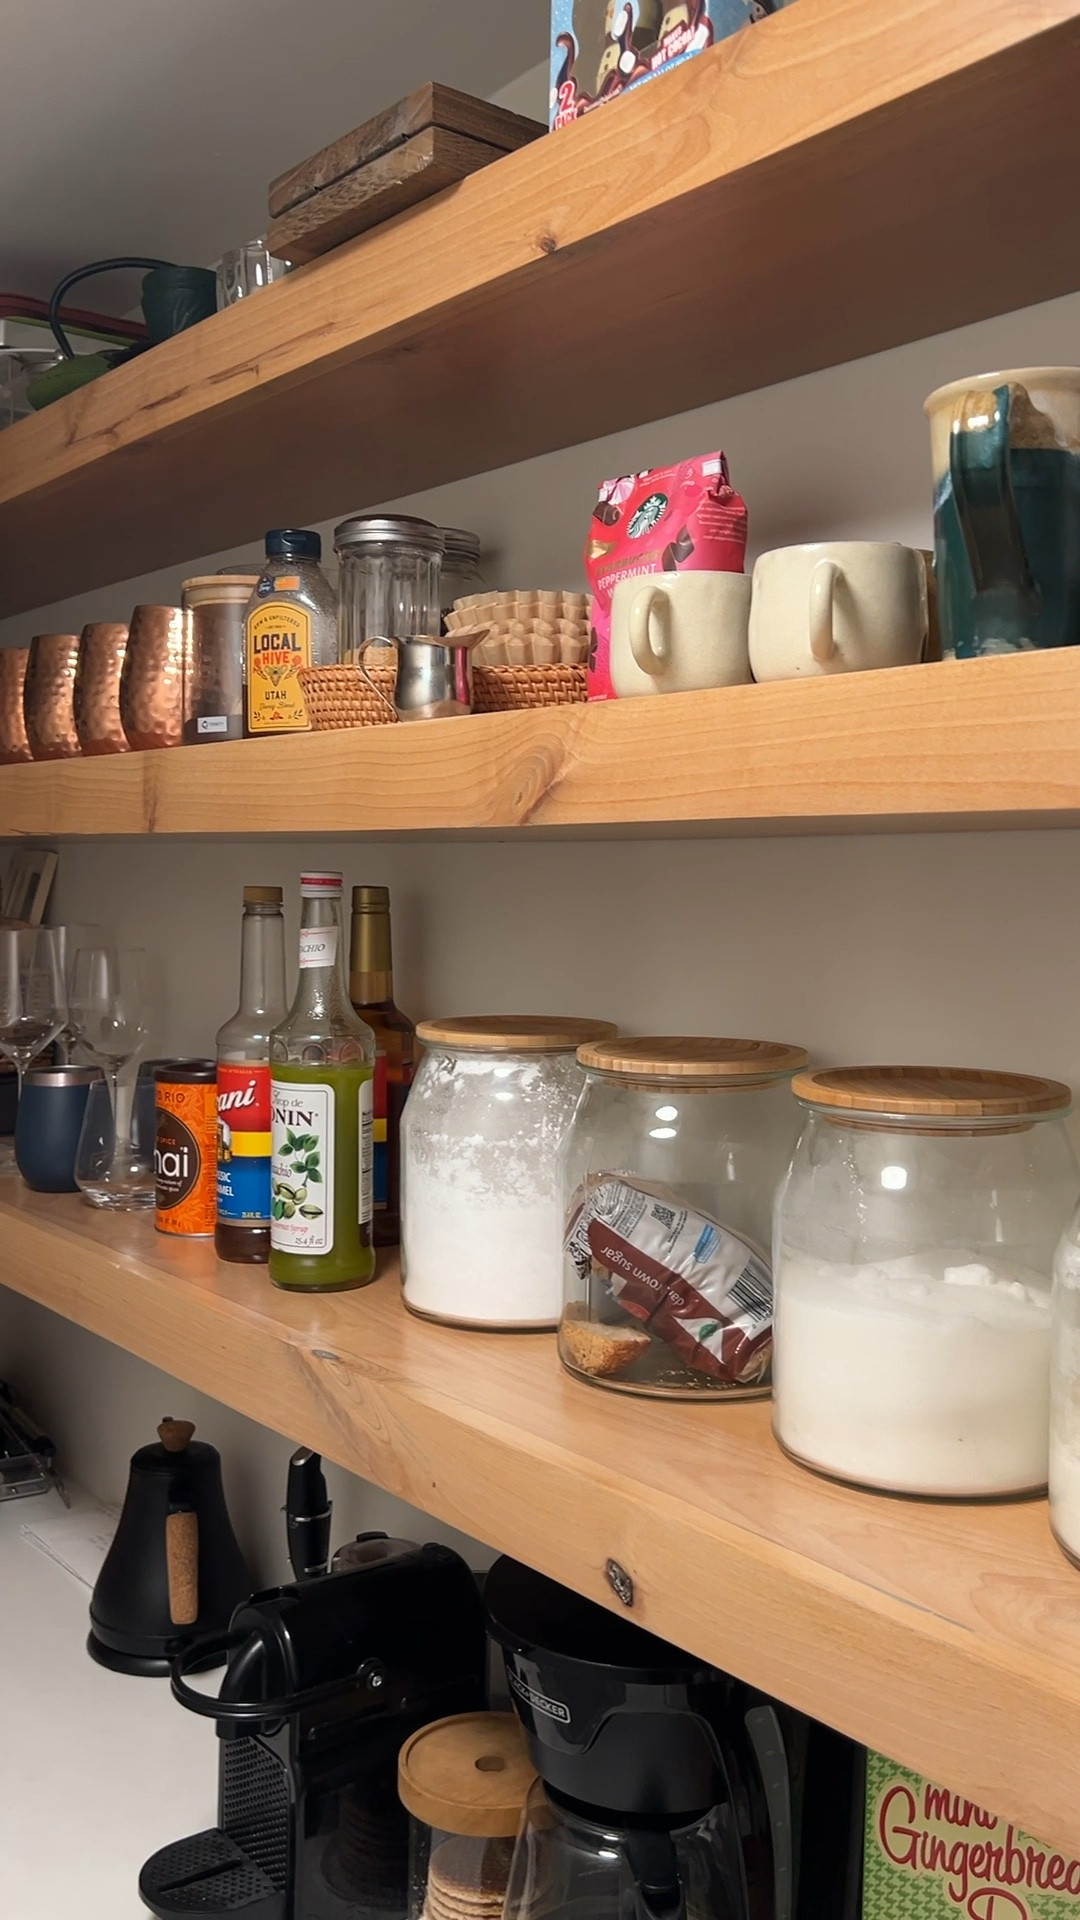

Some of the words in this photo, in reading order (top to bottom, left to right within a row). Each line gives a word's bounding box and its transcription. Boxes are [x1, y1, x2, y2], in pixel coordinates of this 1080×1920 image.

[651, 49, 667, 70] HOT
[559, 80, 576, 114] 2
[597, 563, 657, 591] PEPPERMINT
[254, 633, 302, 654] LOCAL
[263, 651, 290, 665] HIVE
[266, 691, 286, 700] UTAH
[164, 1091, 186, 1104] RIO
[217, 1079, 256, 1111] ani
[600, 1247, 632, 1271] sugar
[632, 1267, 664, 1292] rown
[667, 1286, 686, 1307] dar
